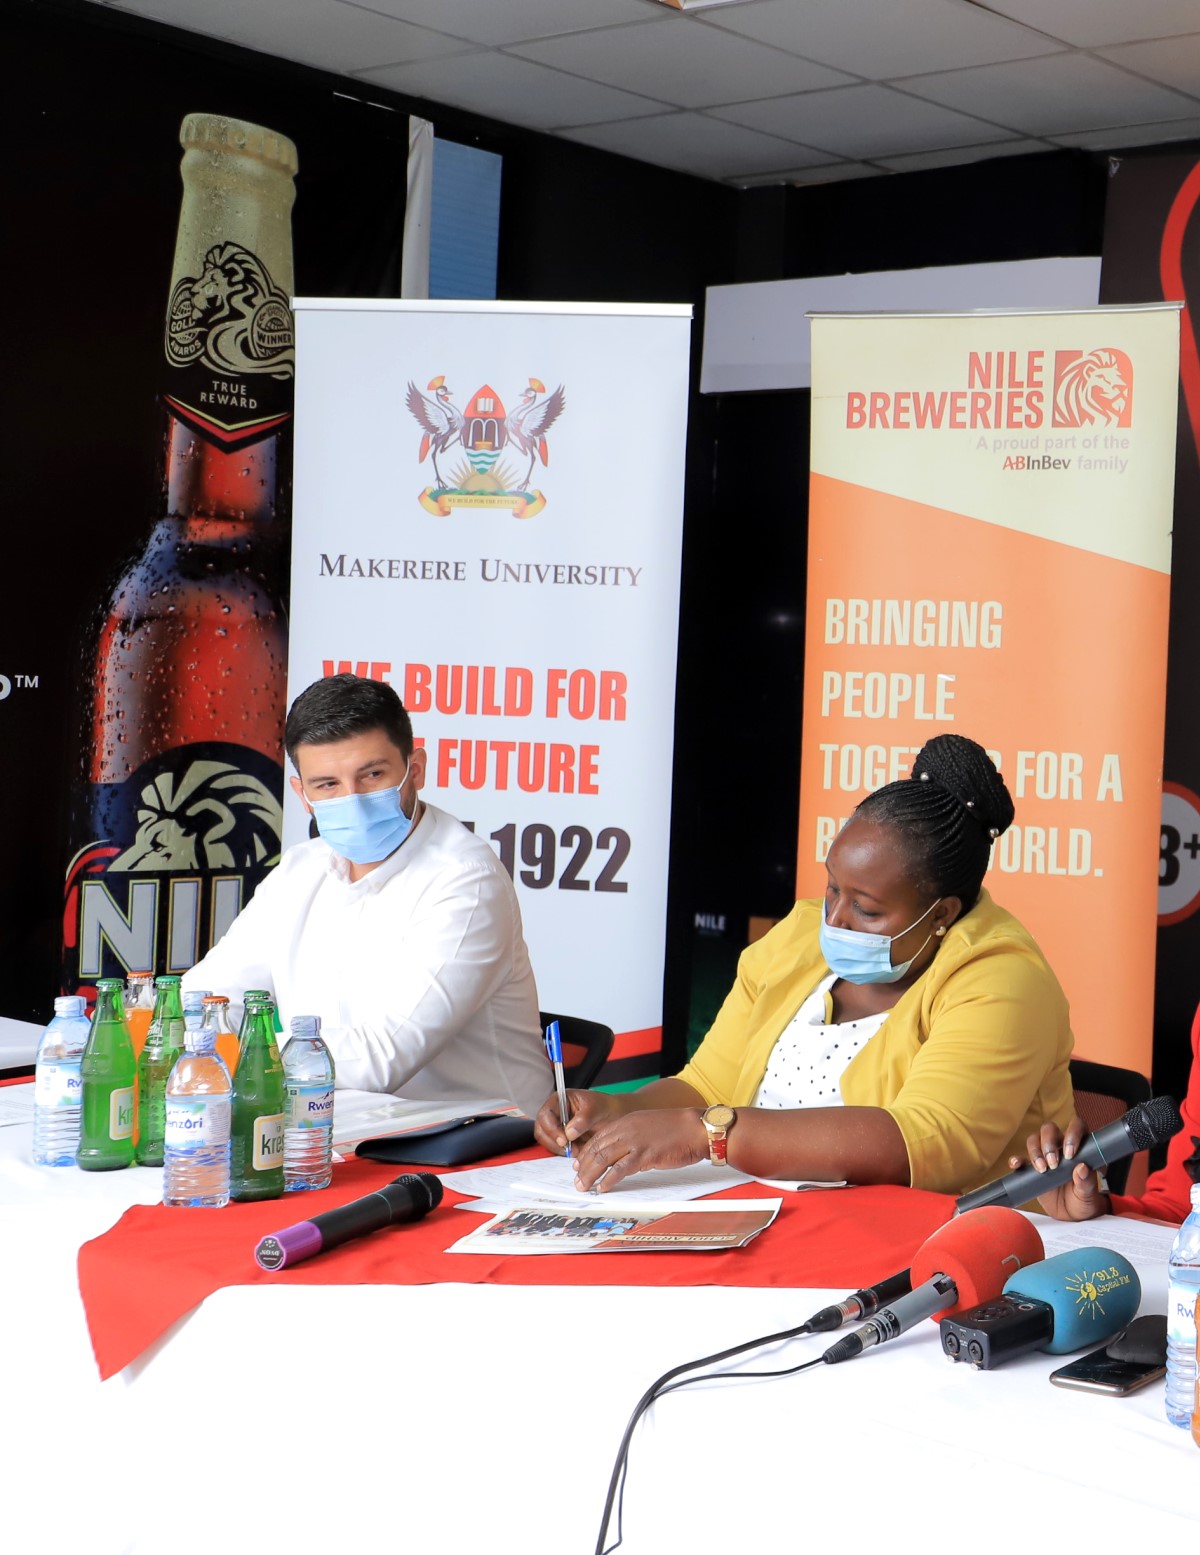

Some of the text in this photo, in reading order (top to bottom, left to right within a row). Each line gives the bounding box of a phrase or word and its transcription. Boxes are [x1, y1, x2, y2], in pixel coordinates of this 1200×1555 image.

[211, 380, 247, 395] TRUE
[968, 350, 1045, 390] NILE
[200, 392, 258, 409] REWARD
[846, 391, 1044, 430] BREWERIES
[975, 434, 1130, 453] A proud part of the
[1002, 455, 1129, 474] ABInBev family
[824, 598, 1003, 649] BRINGING
[403, 663, 534, 718] BUILD
[545, 668, 628, 722] FOR
[821, 671, 956, 721] PEOPLE
[436, 738, 601, 796] FUTURE
[1015, 750, 1083, 801] FOR
[1096, 753, 1124, 802] A
[490, 822, 632, 894] 1922
[694, 913, 727, 931] NILE
